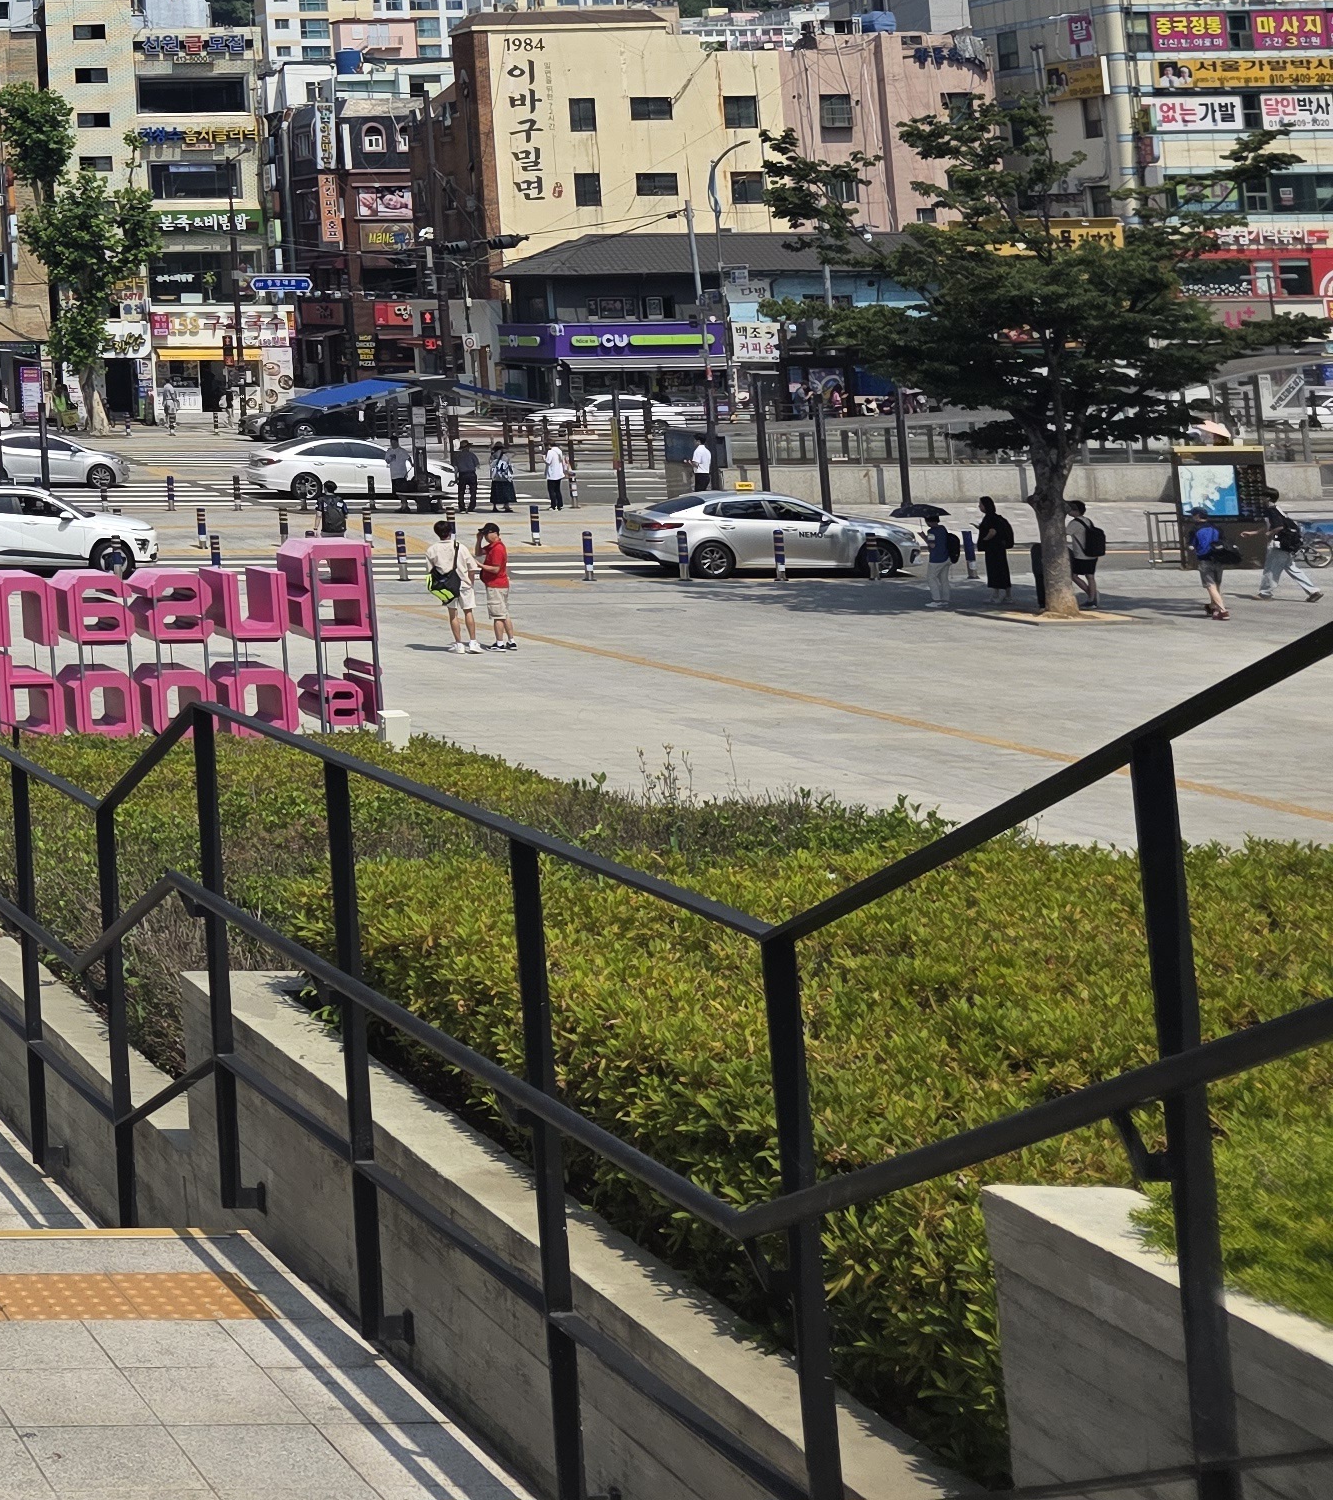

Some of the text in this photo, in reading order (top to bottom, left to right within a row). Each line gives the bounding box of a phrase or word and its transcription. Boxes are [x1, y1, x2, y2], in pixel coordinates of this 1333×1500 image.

[1155, 15, 1323, 36] 중국정통 마사지
[141, 34, 247, 55] 선원 급 모집
[503, 38, 546, 52] 1984
[507, 58, 546, 201] 이바구밀면
[735, 326, 763, 340] 백조
[601, 333, 629, 348] CU
[739, 342, 775, 355] 커피숍
[798, 531, 823, 539] NEMO
